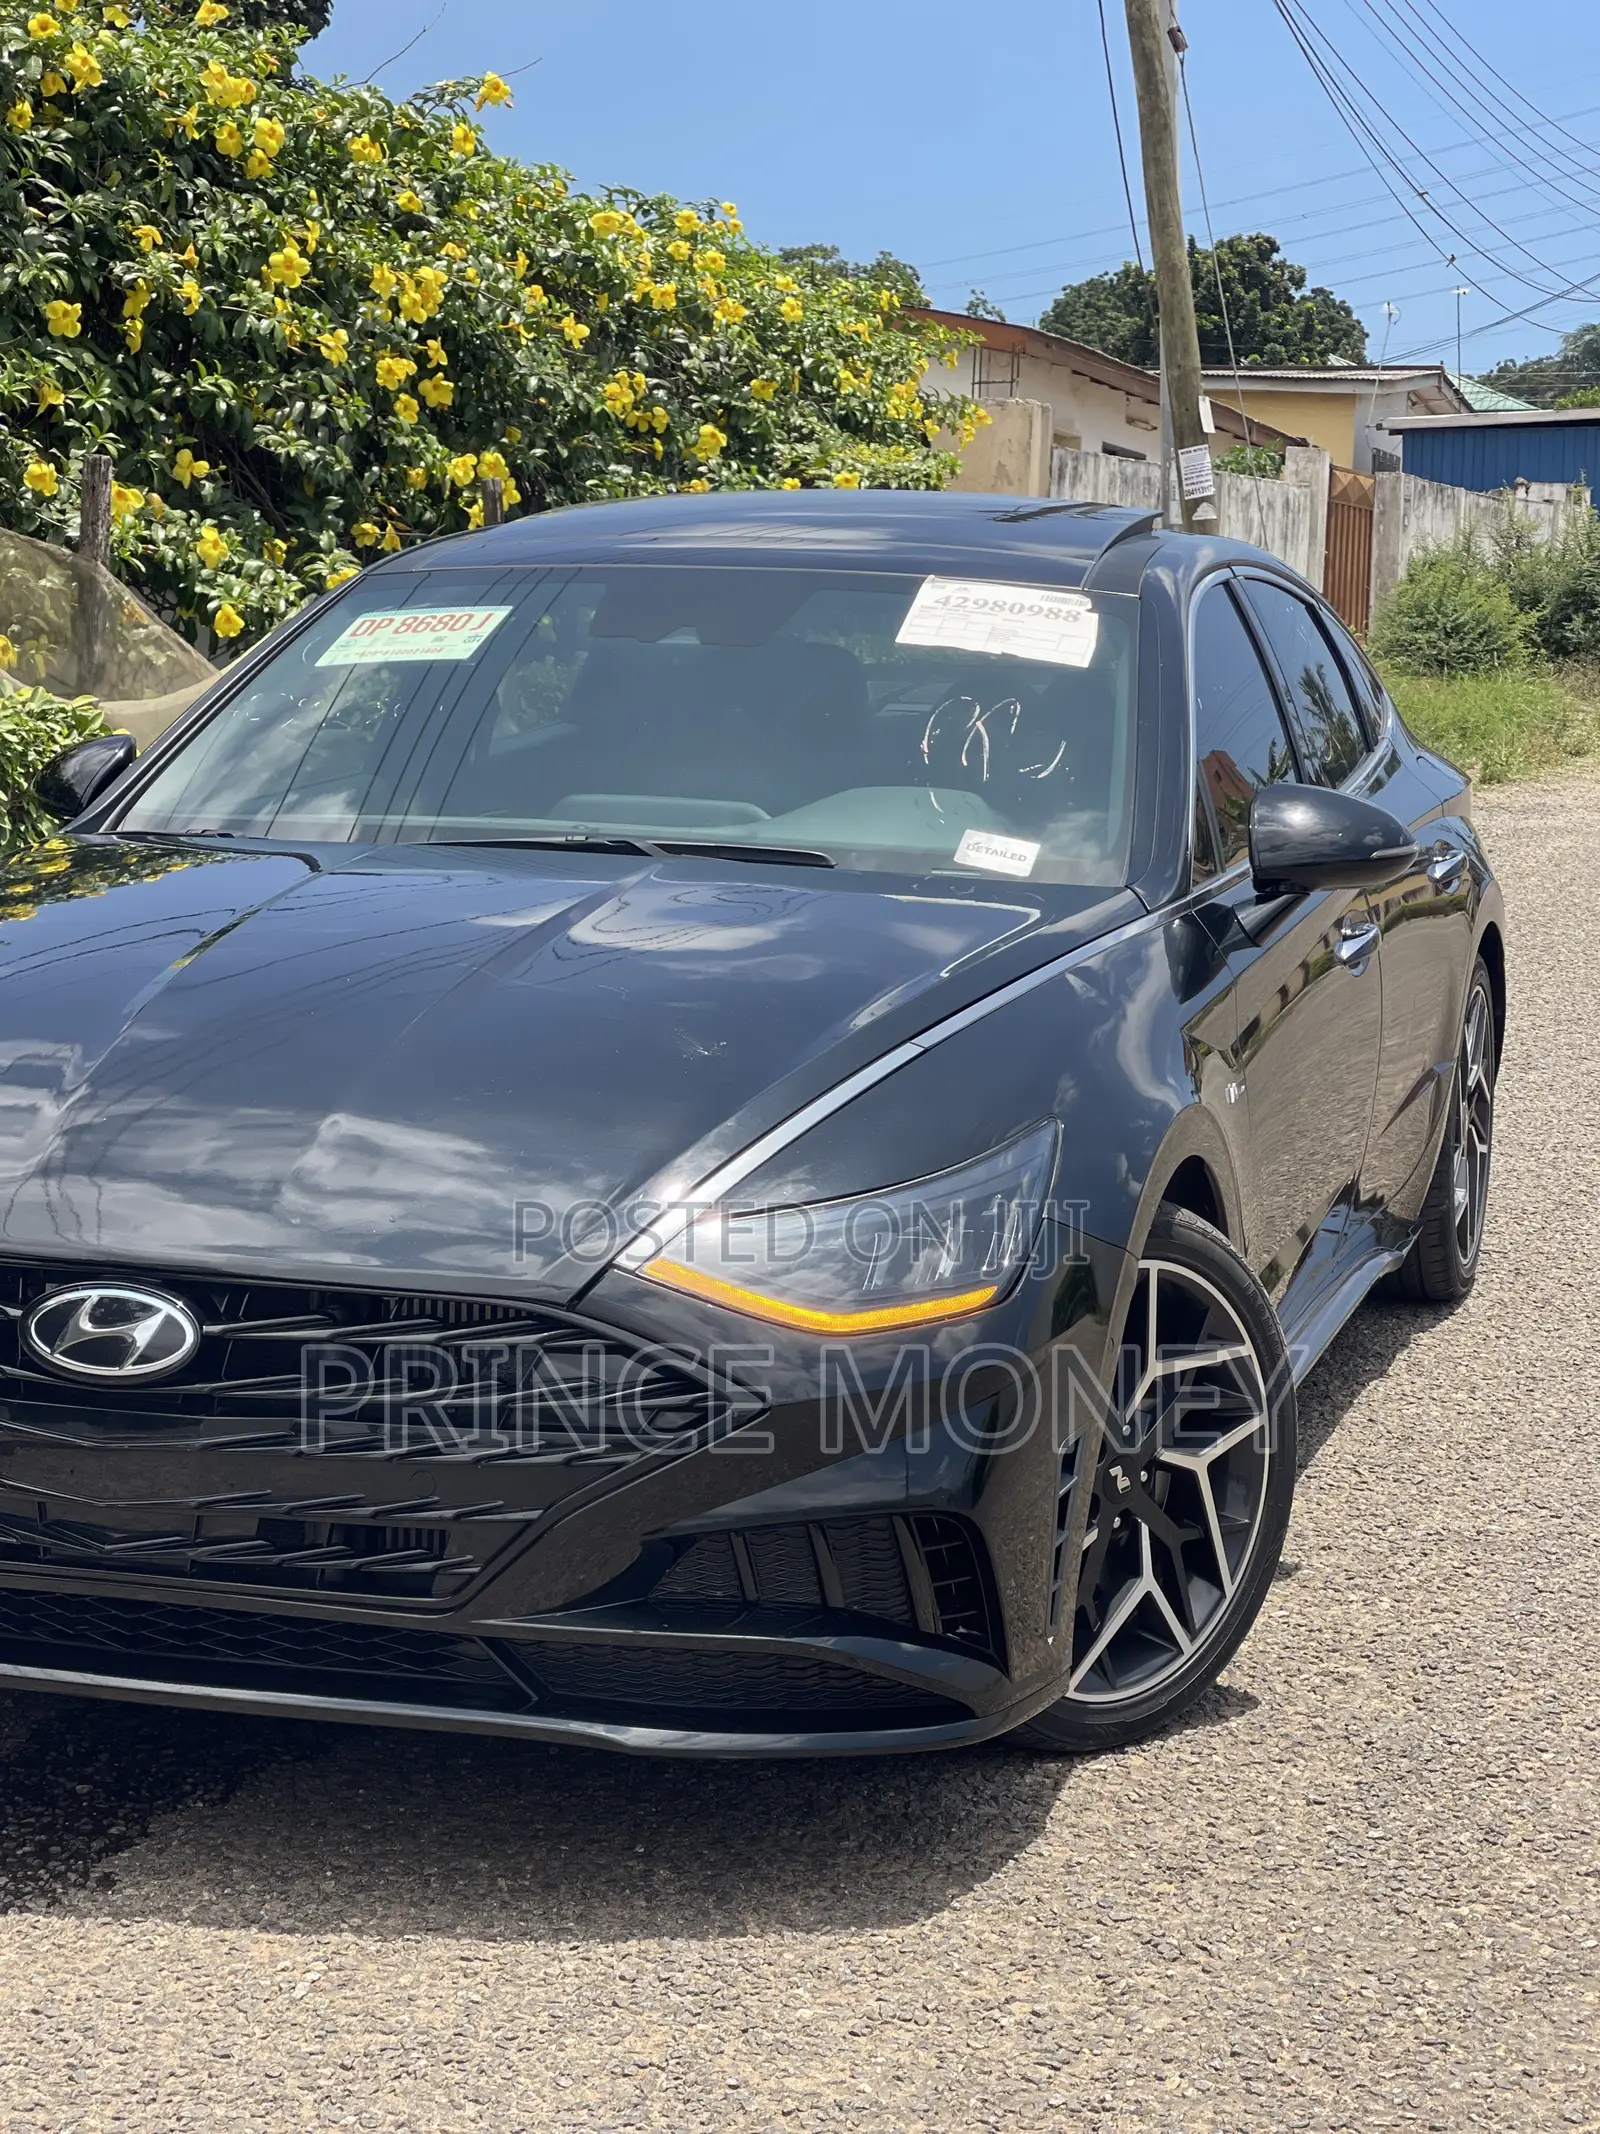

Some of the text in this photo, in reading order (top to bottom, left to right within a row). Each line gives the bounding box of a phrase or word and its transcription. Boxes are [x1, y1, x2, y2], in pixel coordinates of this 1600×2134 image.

[933, 594, 1082, 623] 42980988
[348, 612, 494, 637] DP 8680 J
[965, 843, 1028, 863] DETAILED
